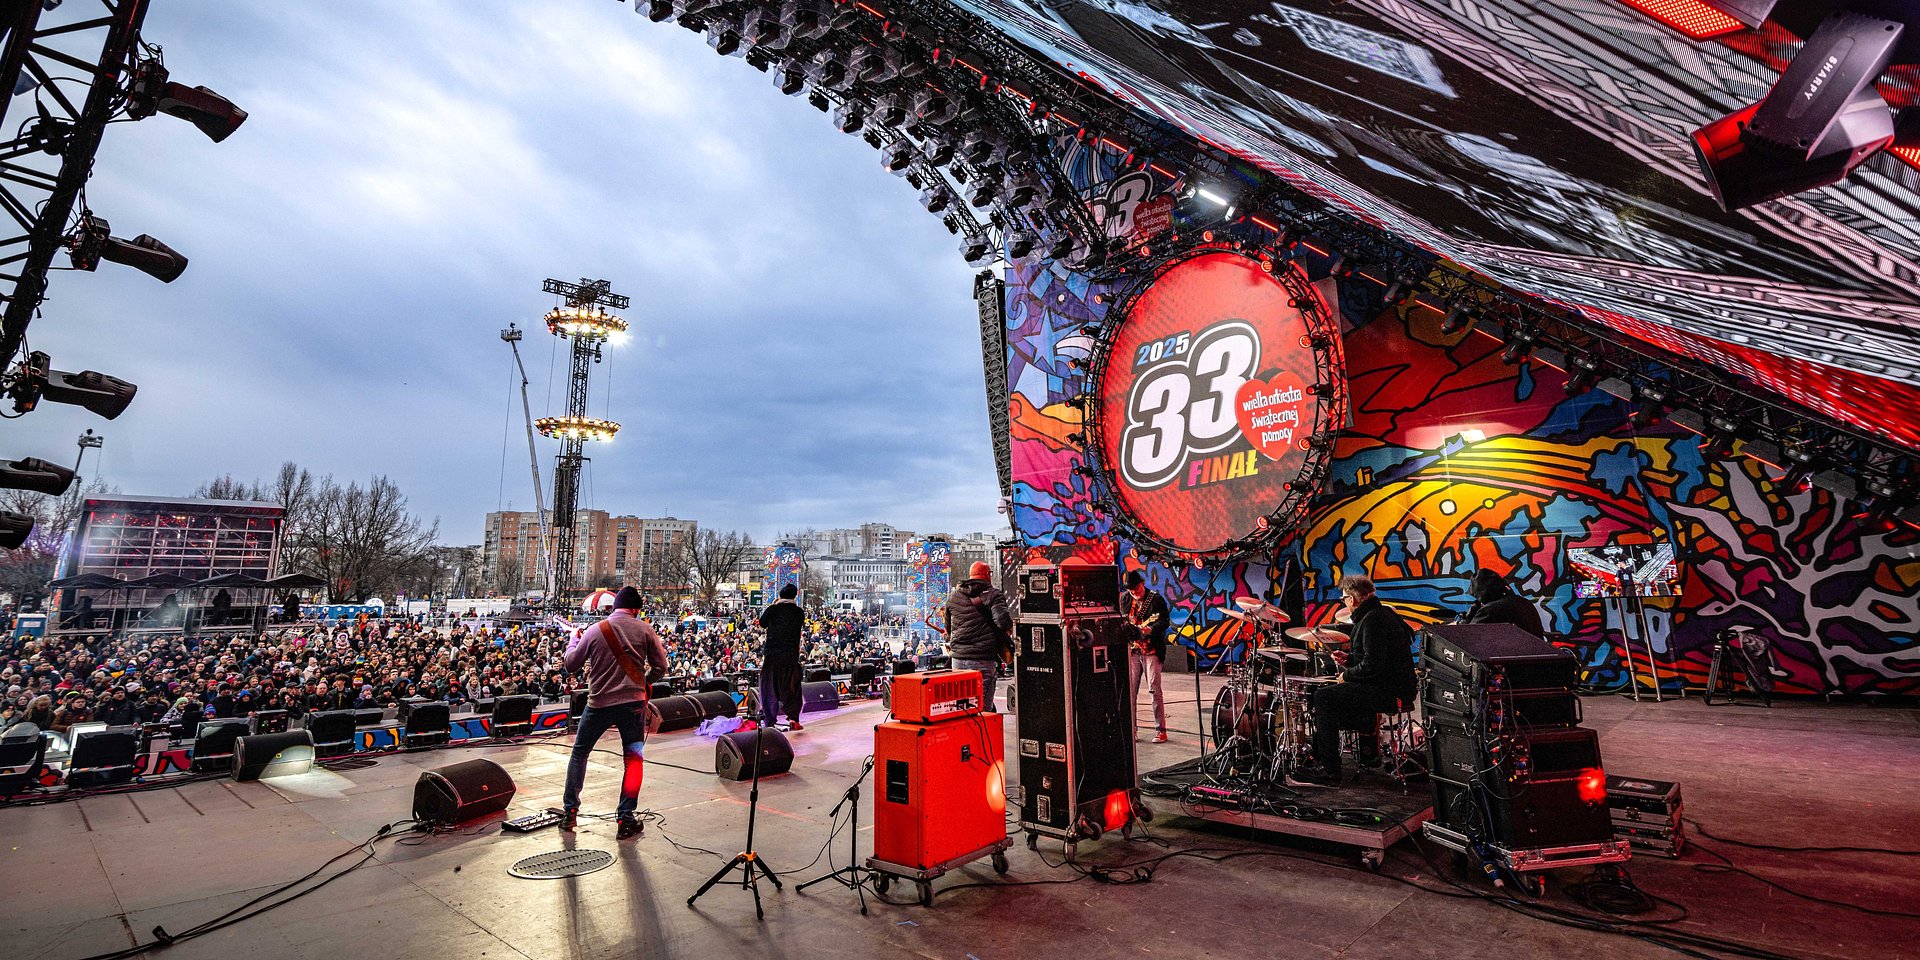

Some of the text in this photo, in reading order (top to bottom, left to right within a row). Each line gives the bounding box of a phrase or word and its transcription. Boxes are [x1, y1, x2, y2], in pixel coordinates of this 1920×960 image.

[1804, 55, 1838, 101] SHARPY
[1136, 332, 1190, 366] 2025
[1130, 332, 1256, 475] 33
[1242, 385, 1302, 412] wielka orkiestra
[1251, 405, 1299, 429] świątecznej
[1261, 427, 1293, 448] pomocy
[1187, 449, 1258, 487] FINAŁ
[764, 551, 776, 564] 33
[781, 552, 796, 564] 33
[908, 547, 924, 563] 33
[931, 547, 946, 562] 33
